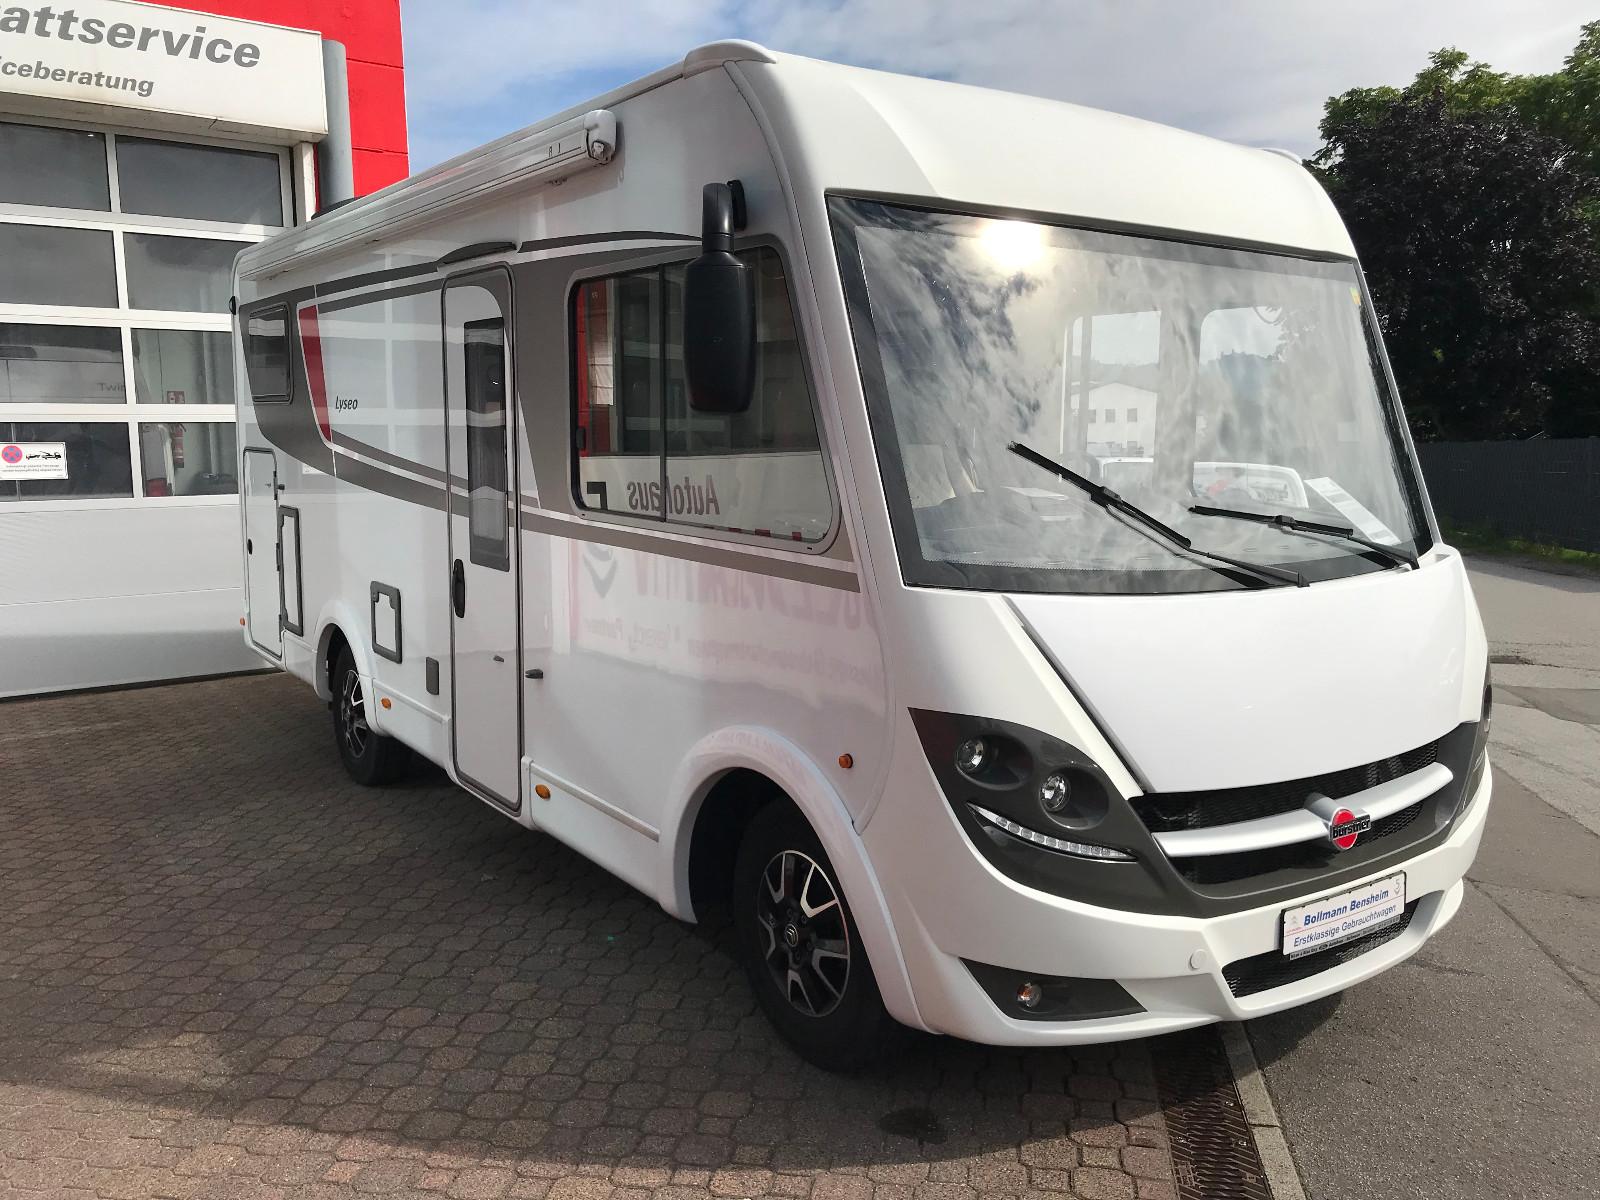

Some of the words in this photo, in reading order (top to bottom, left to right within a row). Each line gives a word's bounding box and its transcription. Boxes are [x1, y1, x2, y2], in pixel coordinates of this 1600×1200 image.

[0, 56, 154, 97] ceberatung
[335, 396, 358, 413] Lyseo
[1293, 925, 1340, 947] Erstklassige
[1341, 904, 1397, 932] Gebrauchtwagen
[1303, 905, 1348, 926] Bollmann
[1349, 890, 1389, 912] Bensheim
